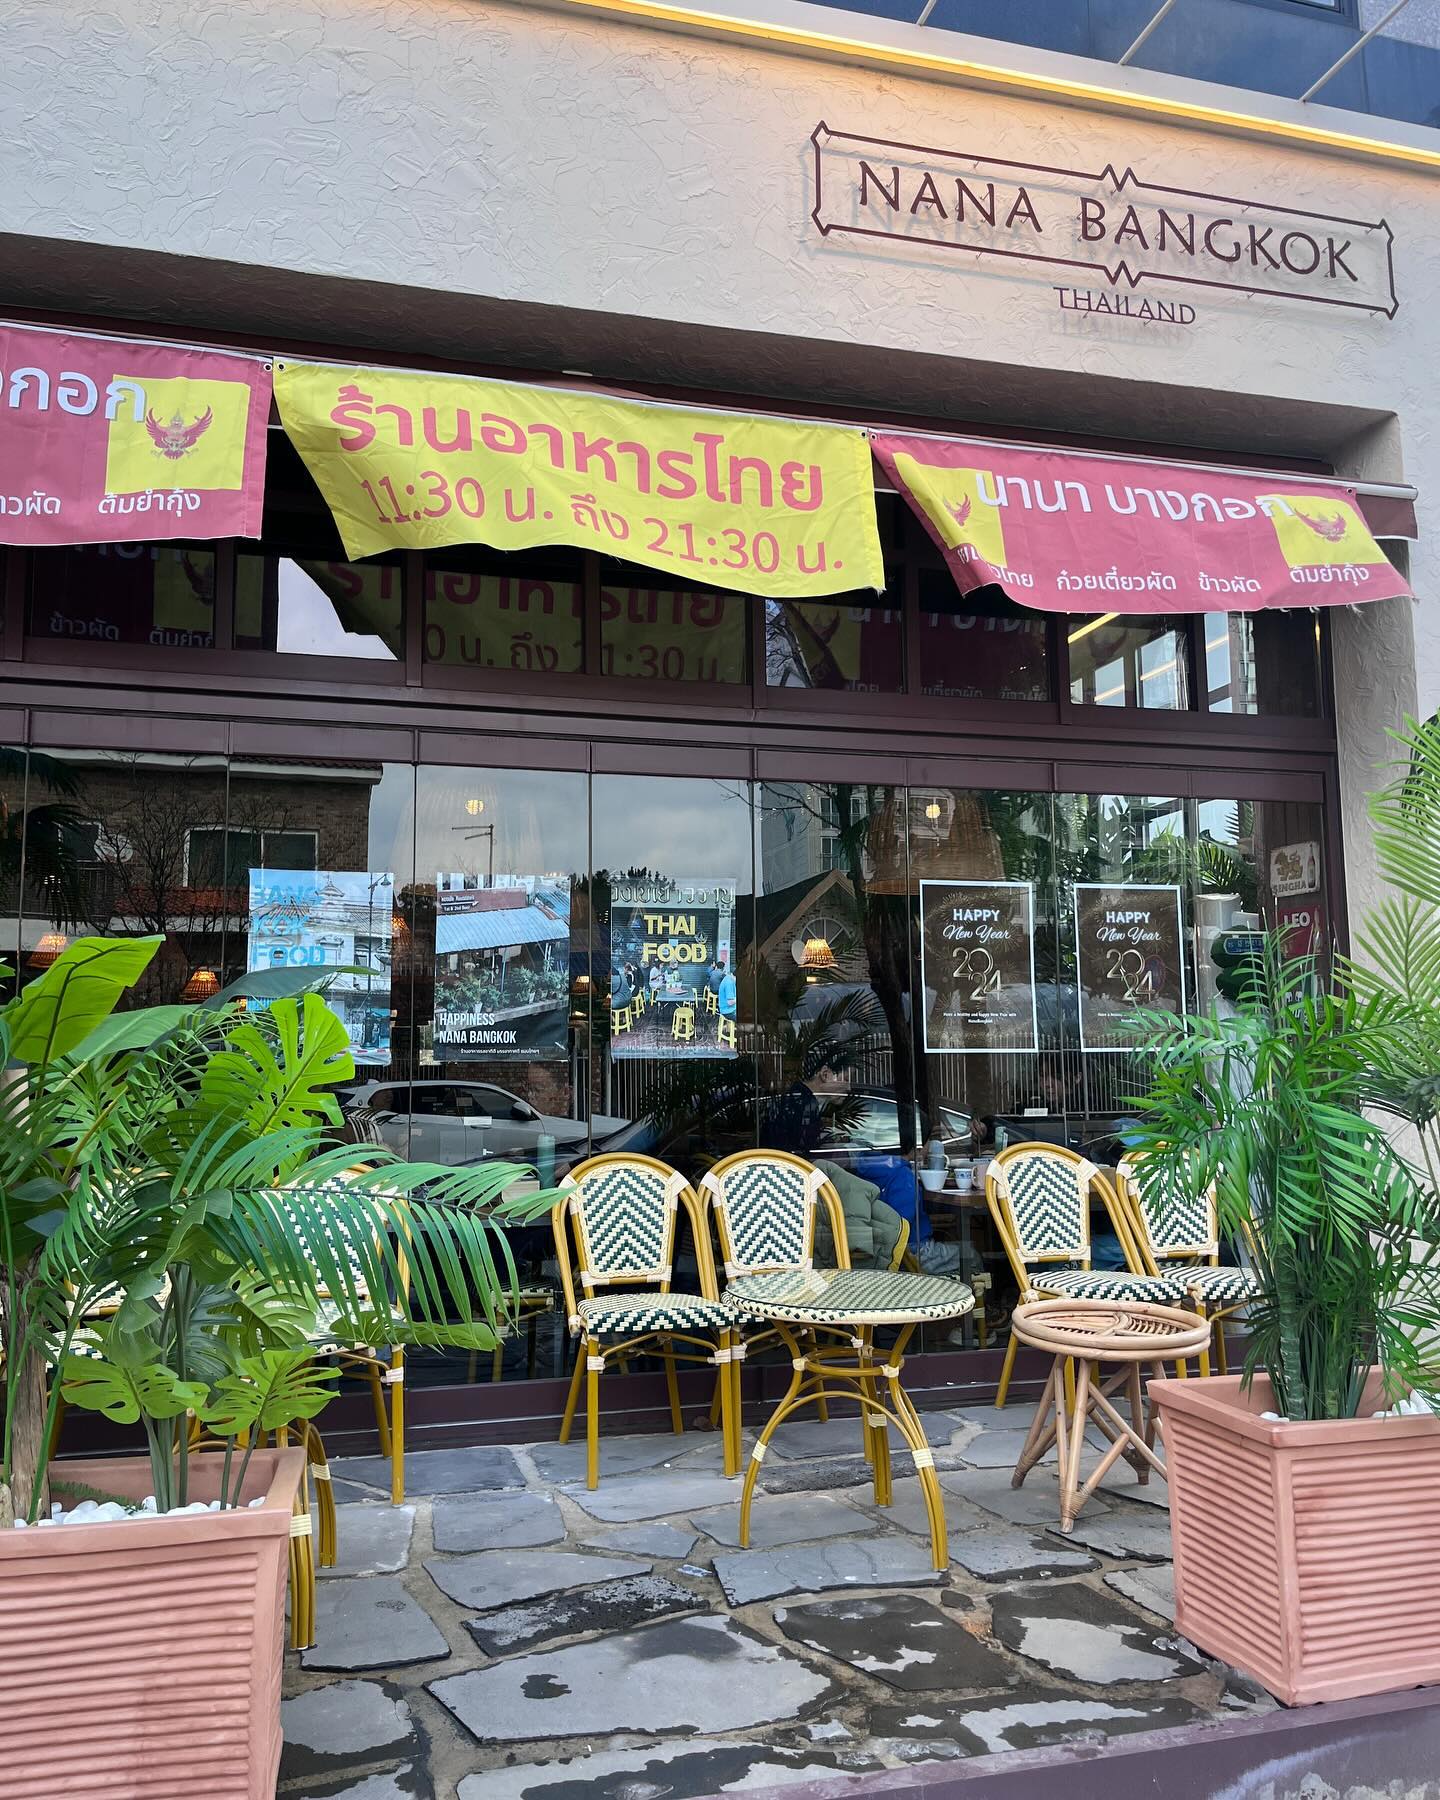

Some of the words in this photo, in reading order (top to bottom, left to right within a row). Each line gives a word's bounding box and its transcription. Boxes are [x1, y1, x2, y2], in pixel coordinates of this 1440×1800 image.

[858, 159, 1043, 234] NANA
[1079, 196, 1359, 283] BANGKOK
[1052, 286, 1196, 325] THAILAND
[0, 365, 146, 423] กอก
[331, 385, 823, 512] ร้านอาหารไทย
[0, 490, 61, 516] าวผัด
[975, 470, 1091, 513] นานา
[1104, 481, 1296, 523] บางกอก
[361, 470, 485, 523] 11:30
[505, 488, 553, 522] น.
[570, 493, 629, 540] ถึง
[643, 517, 779, 573] 21:30
[797, 540, 843, 574] น.
[1198, 571, 1262, 593] ข้าวผัด
[644, 914, 697, 935] THAI
[953, 908, 1000, 922] HAPPY
[1106, 911, 1150, 924] HAPPY
[1284, 912, 1310, 927] LEO
[943, 925, 973, 940] New
[977, 925, 1011, 944] Year
[1096, 926, 1127, 942] New
[1128, 926, 1161, 945] Year
[252, 945, 325, 966] FOOD
[642, 943, 708, 963] FOOD
[440, 1012, 495, 1026] HAPPINESS
[439, 1030, 467, 1043] NANA
[469, 1030, 517, 1043] BANGKOK
